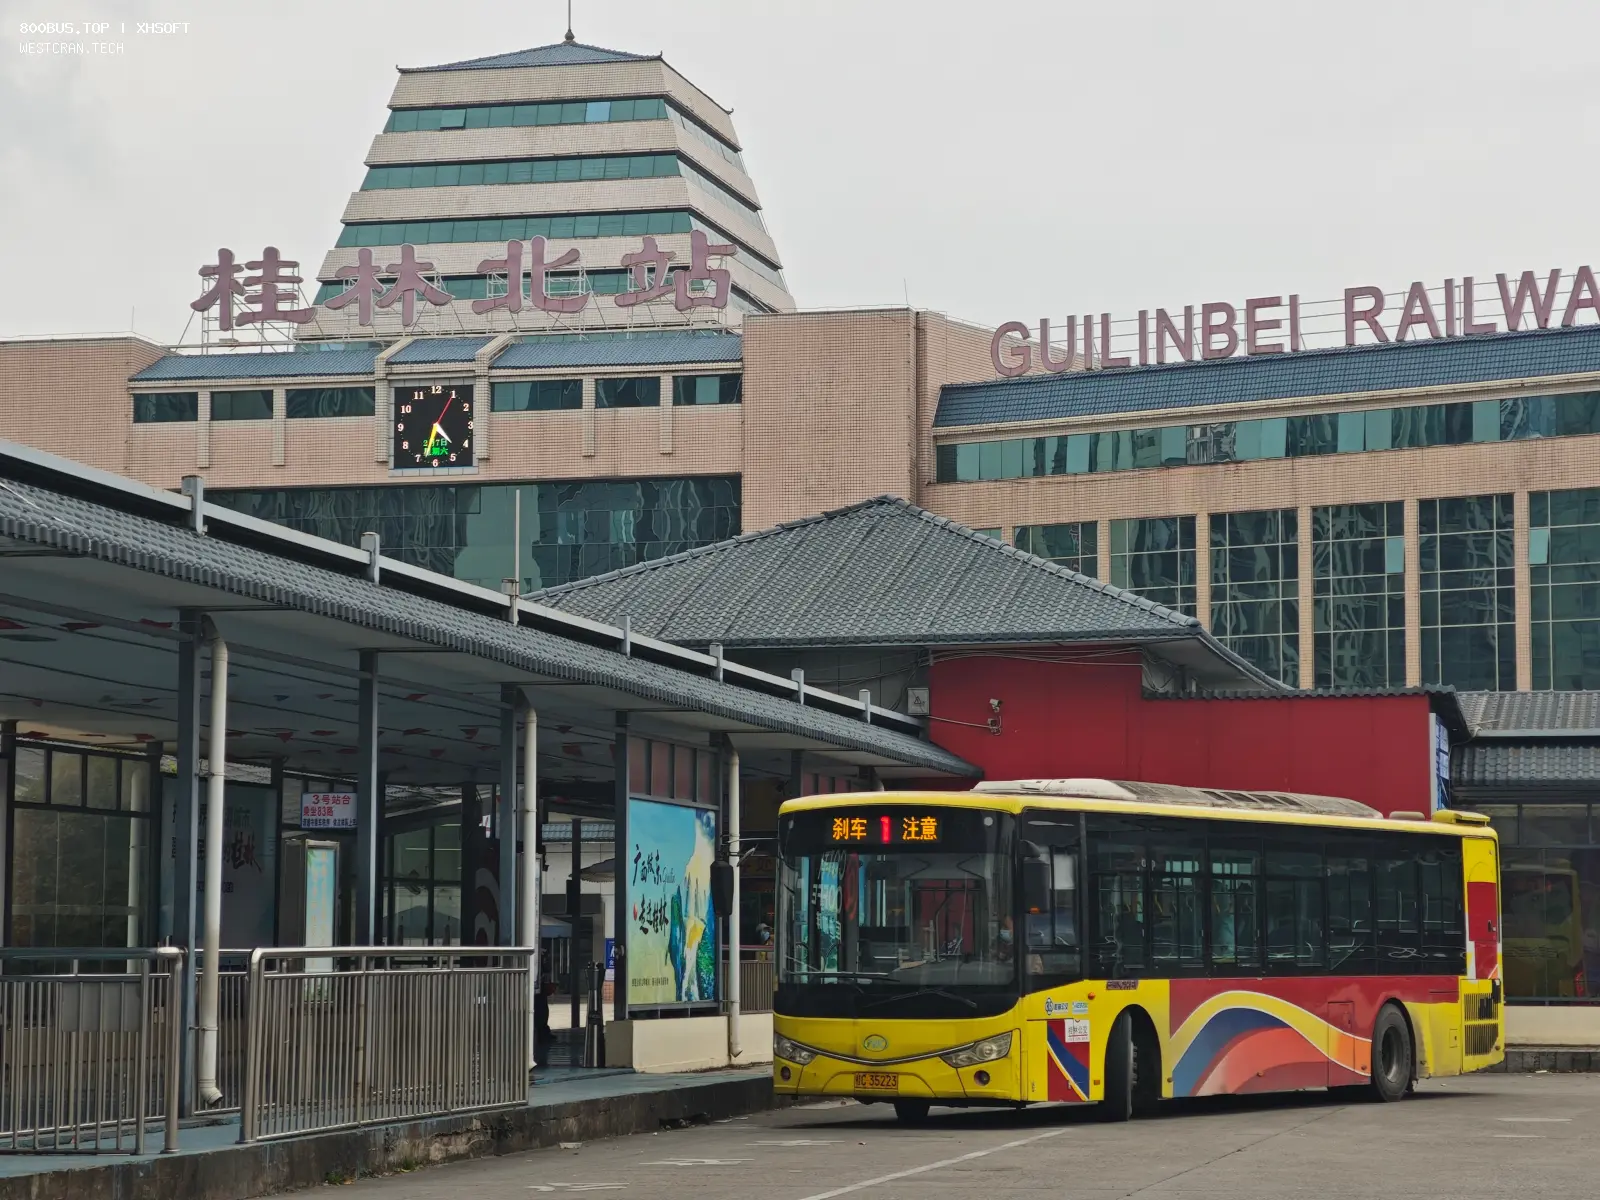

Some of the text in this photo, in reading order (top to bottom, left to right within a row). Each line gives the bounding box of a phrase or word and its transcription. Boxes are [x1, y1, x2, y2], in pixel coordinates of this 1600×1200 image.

[191, 230, 738, 331] 桂林北站
[990, 265, 1600, 377] GUILINBEI RAILWA
[431, 385, 442, 394] 12
[413, 391, 424, 399] 11
[450, 390, 456, 399] 1
[401, 405, 412, 413] 10
[463, 403, 469, 411] 2
[397, 423, 404, 432] 9
[467, 421, 474, 429] 3
[402, 441, 409, 449] 8
[463, 439, 469, 448] 4
[415, 454, 421, 462] 7
[450, 453, 456, 461] 5
[432, 459, 439, 467] 6
[312, 794, 351, 805] 3号站台
[303, 806, 334, 817] 乘坐83路
[832, 815, 937, 844] 刹车 1 注意
